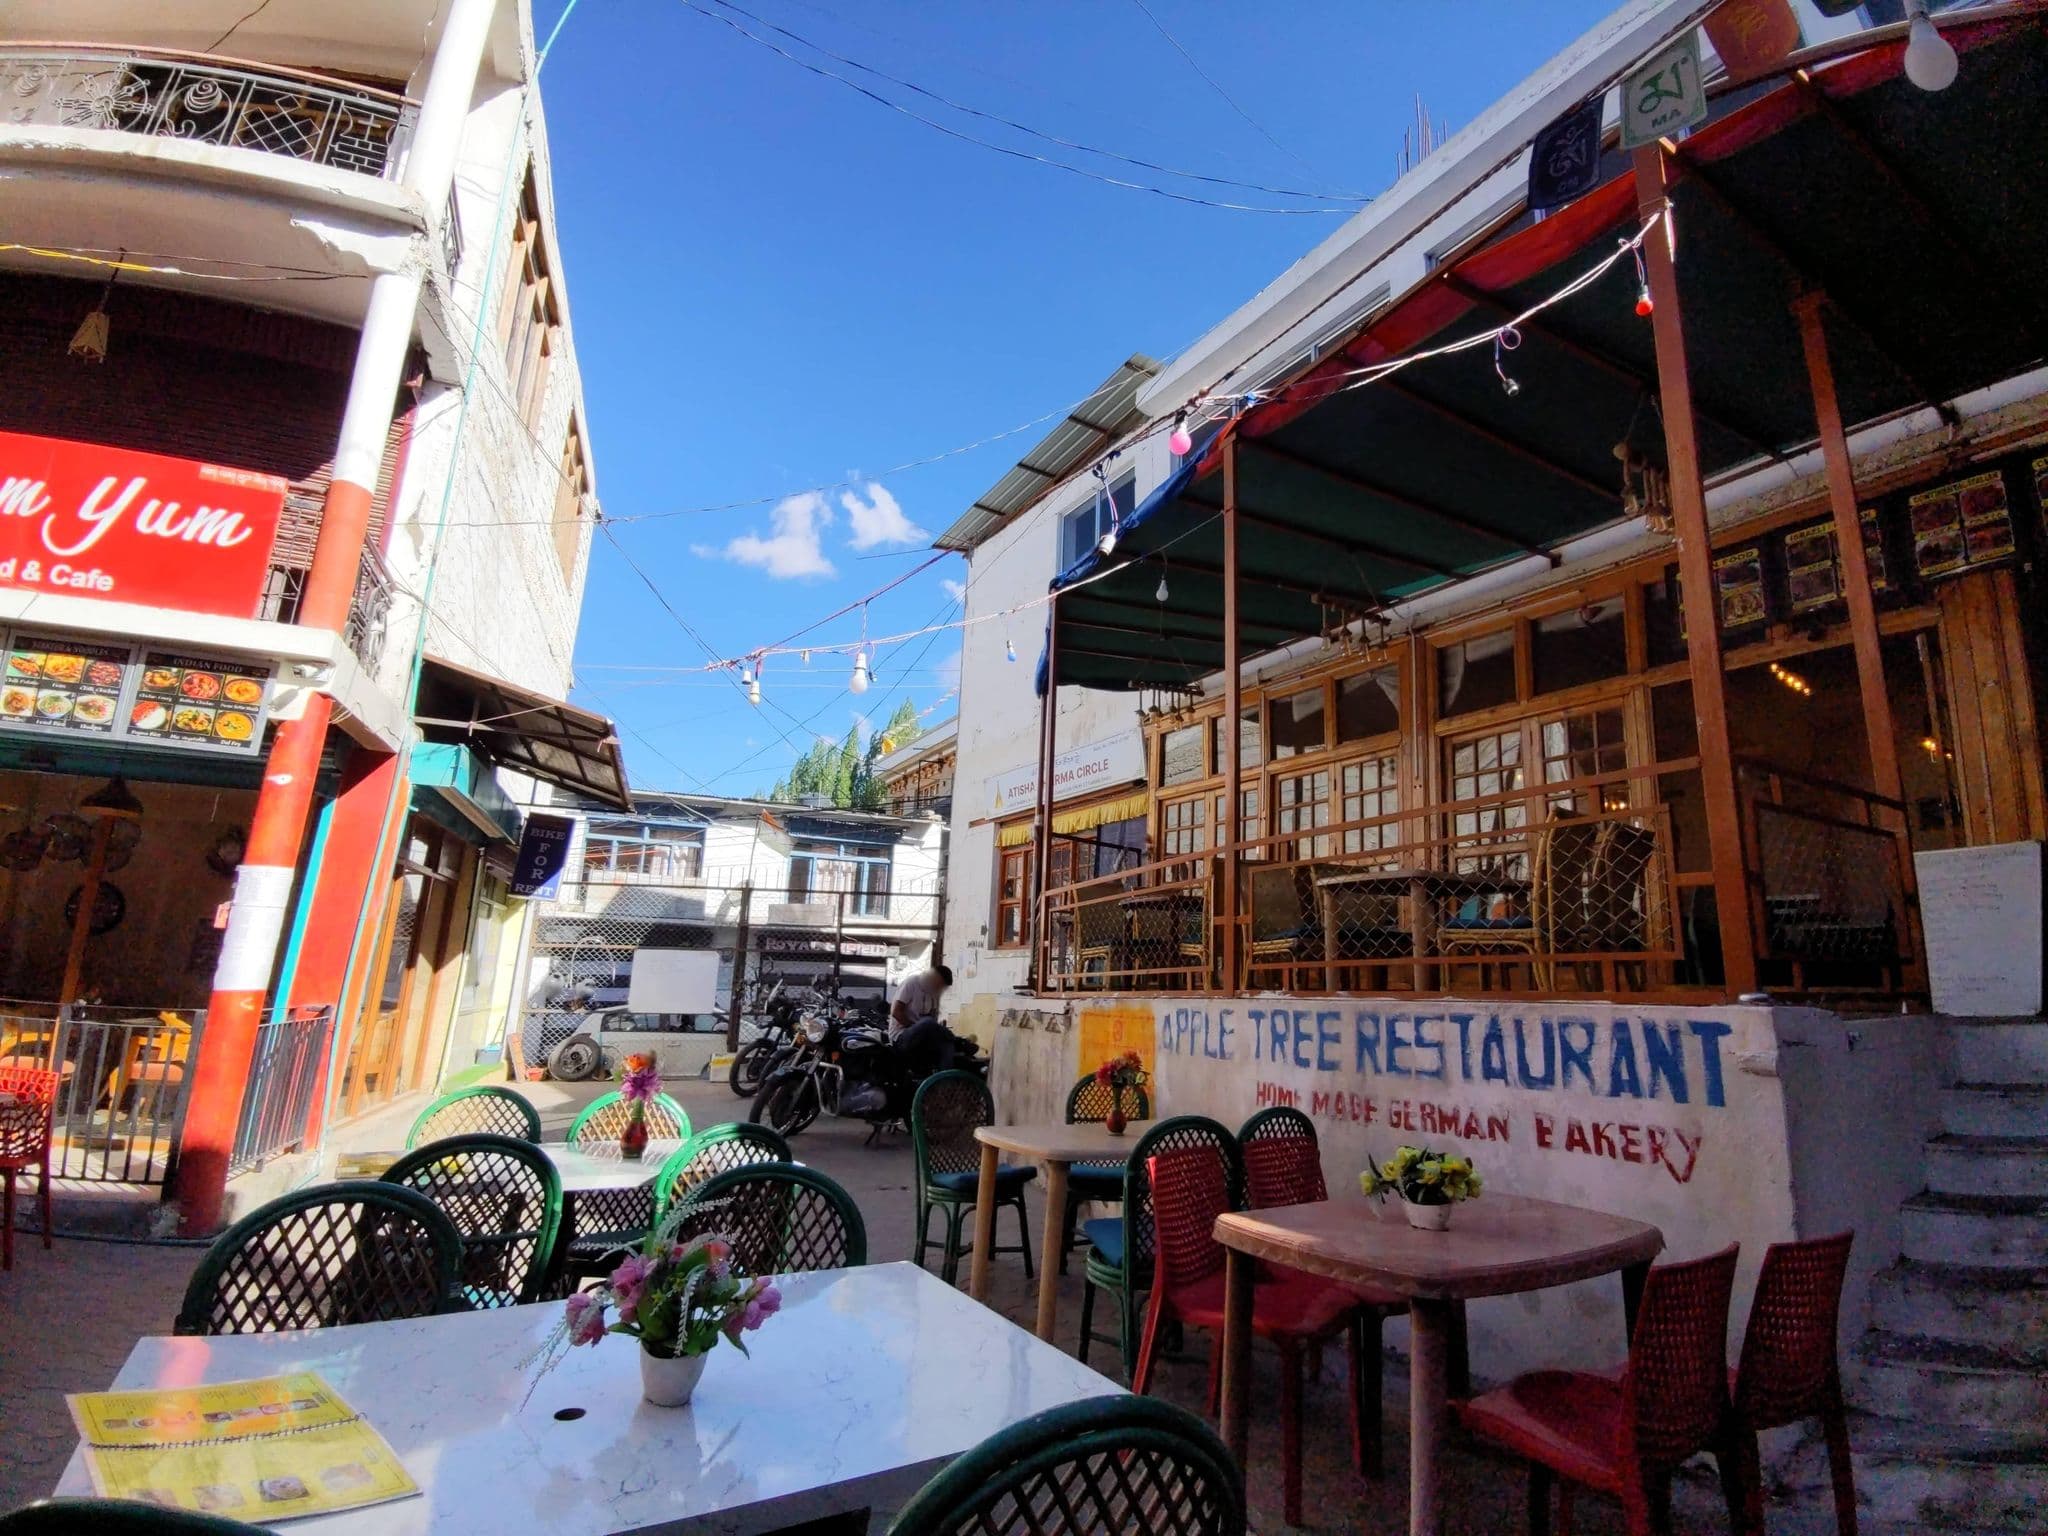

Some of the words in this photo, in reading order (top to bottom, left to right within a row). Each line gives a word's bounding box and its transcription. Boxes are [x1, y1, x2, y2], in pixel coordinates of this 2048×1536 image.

[1652, 109, 1681, 128] MA
[41, 476, 253, 556] Yum
[1722, 550, 1754, 567] FOOD
[21, 560, 42, 583] &
[50, 564, 114, 591] Cafe
[173, 658, 212, 669] INDIAN
[213, 663, 243, 673] FOOD
[1008, 781, 1036, 799] ATISHA
[1076, 758, 1110, 779] CIRCLE
[530, 827, 567, 840] BIKE
[514, 883, 554, 897] RENT
[1162, 1007, 1235, 1060] APPLE
[1248, 1008, 1342, 1071] TREE
[1355, 1010, 1734, 1108] RESTAURANT
[1388, 1099, 1511, 1143] GERMAN
[1534, 1111, 1702, 1185] BAKERY
